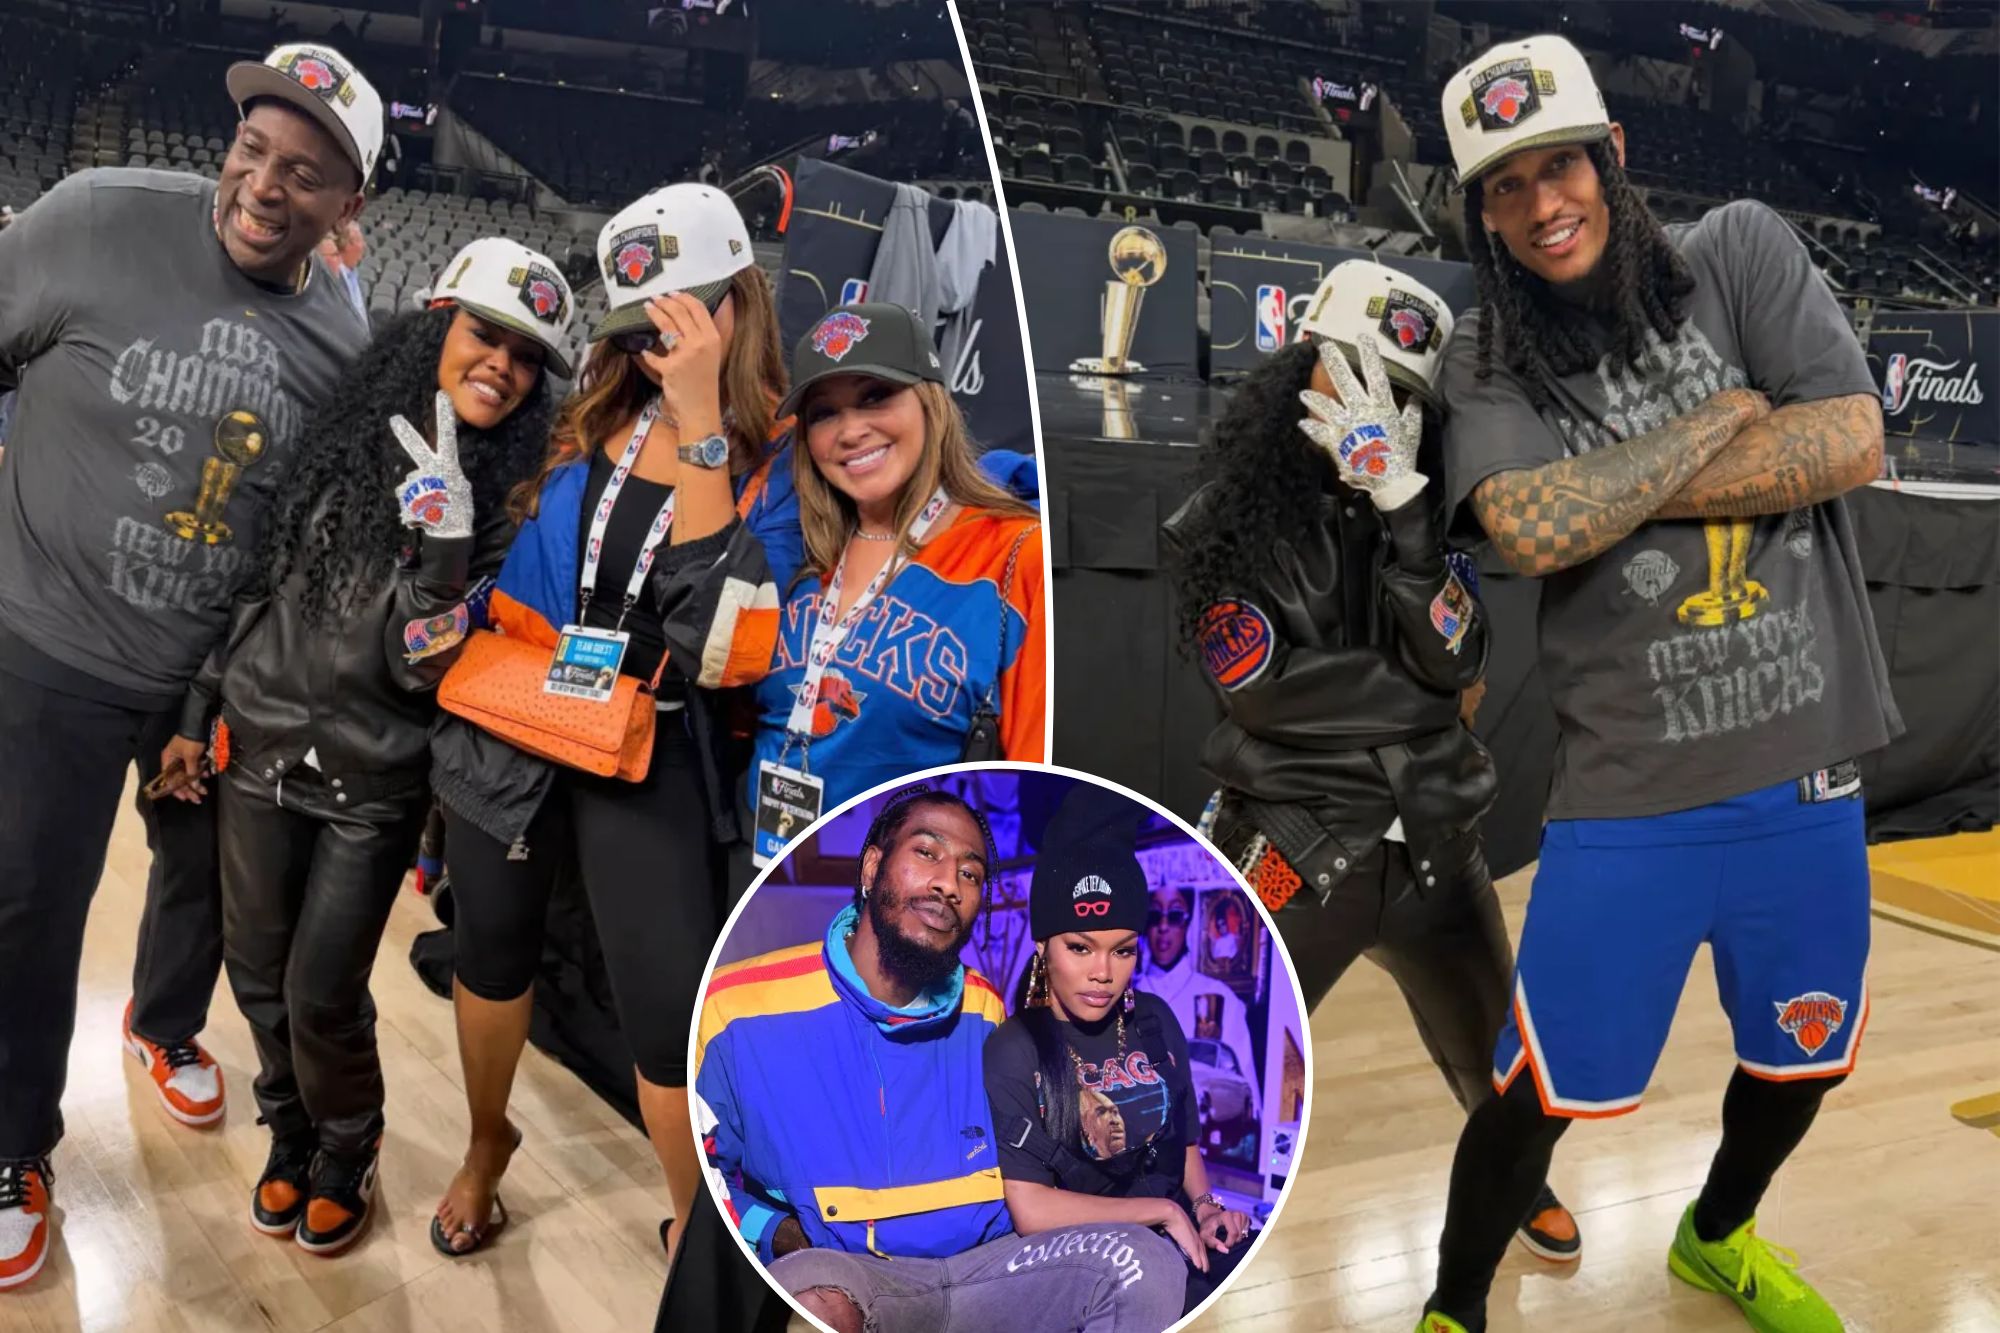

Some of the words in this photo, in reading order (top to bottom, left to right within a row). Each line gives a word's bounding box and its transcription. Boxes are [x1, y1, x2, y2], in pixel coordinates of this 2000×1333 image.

[1888, 358, 1984, 416] Finals
[130, 416, 186, 455] 20
[1006, 1230, 1144, 1290] Collection
